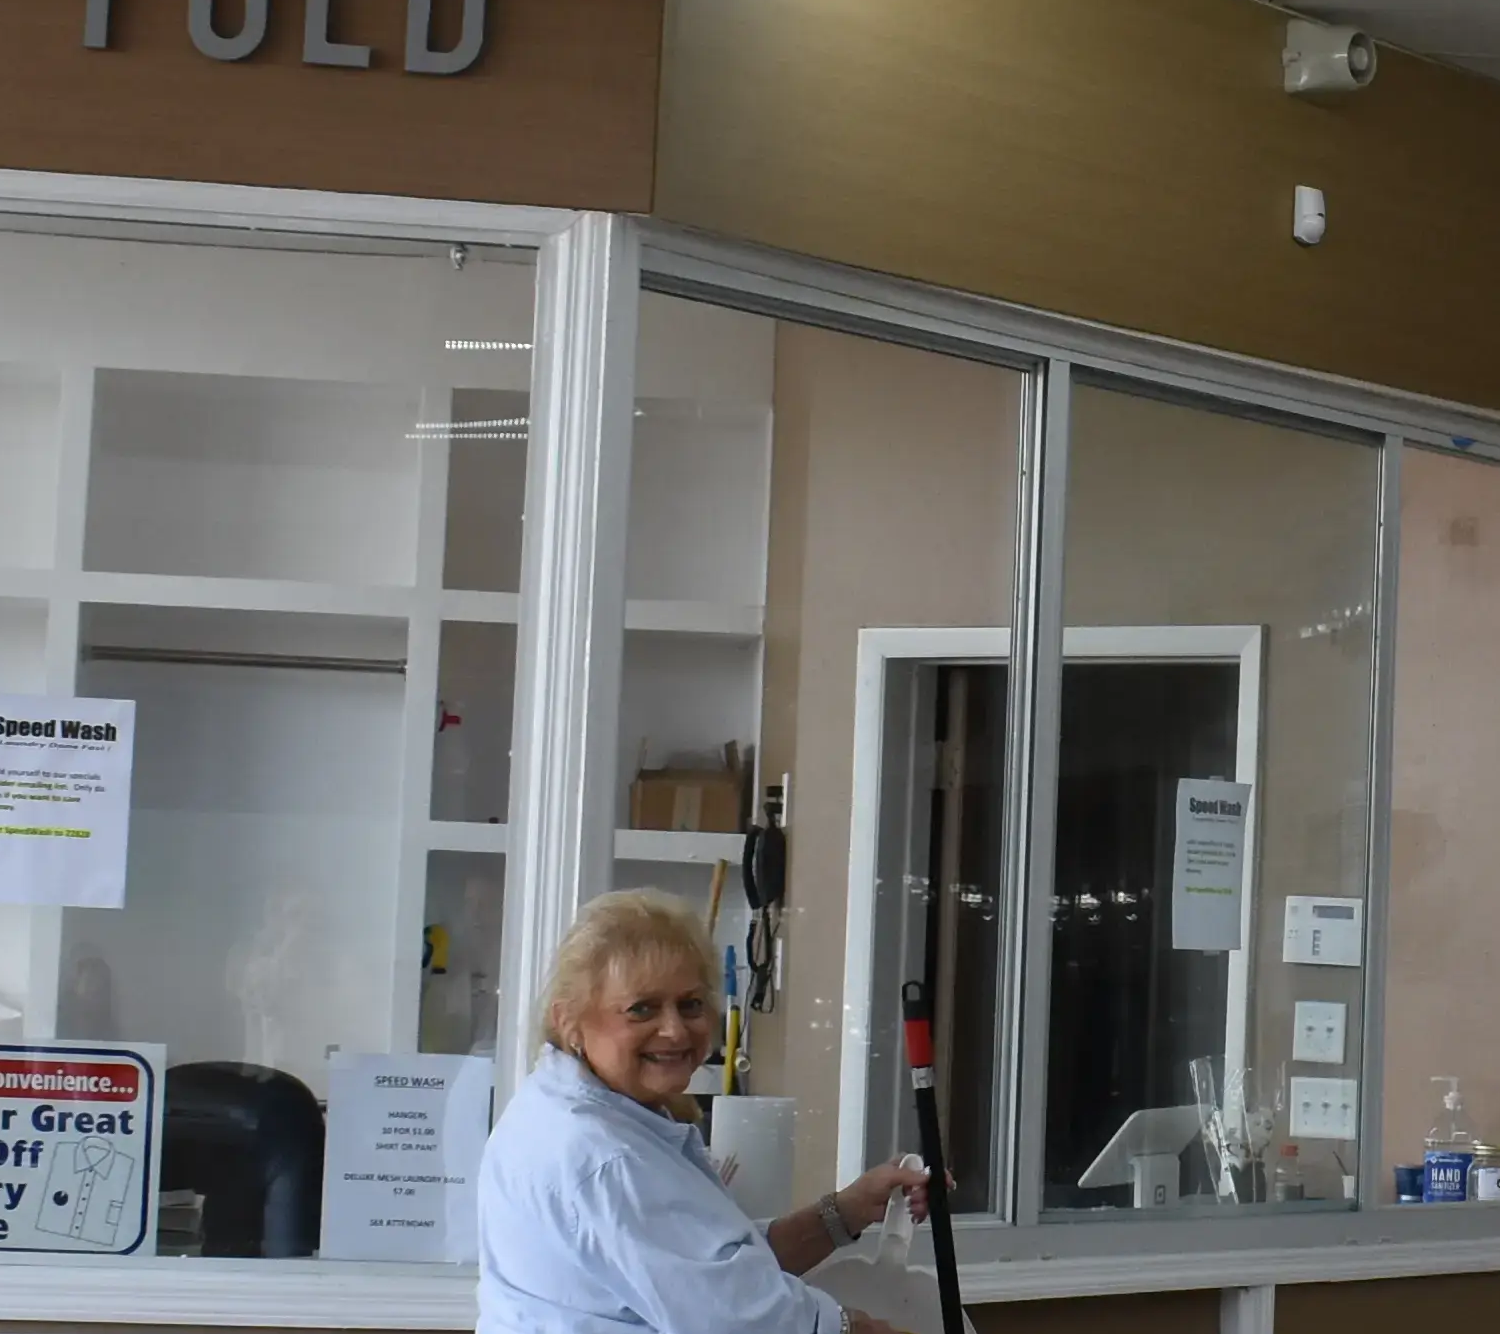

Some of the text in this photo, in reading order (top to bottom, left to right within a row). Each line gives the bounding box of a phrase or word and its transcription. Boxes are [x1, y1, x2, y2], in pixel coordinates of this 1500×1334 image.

[60, 720, 117, 742] Wash
[374, 1075, 444, 1087] SPEED WASH
[31, 1104, 134, 1135] Great
[388, 1111, 427, 1120] HANGERS
[394, 1127, 410, 1135] FOR
[415, 1143, 438, 1152] PANT
[1431, 1168, 1460, 1182] HAND
